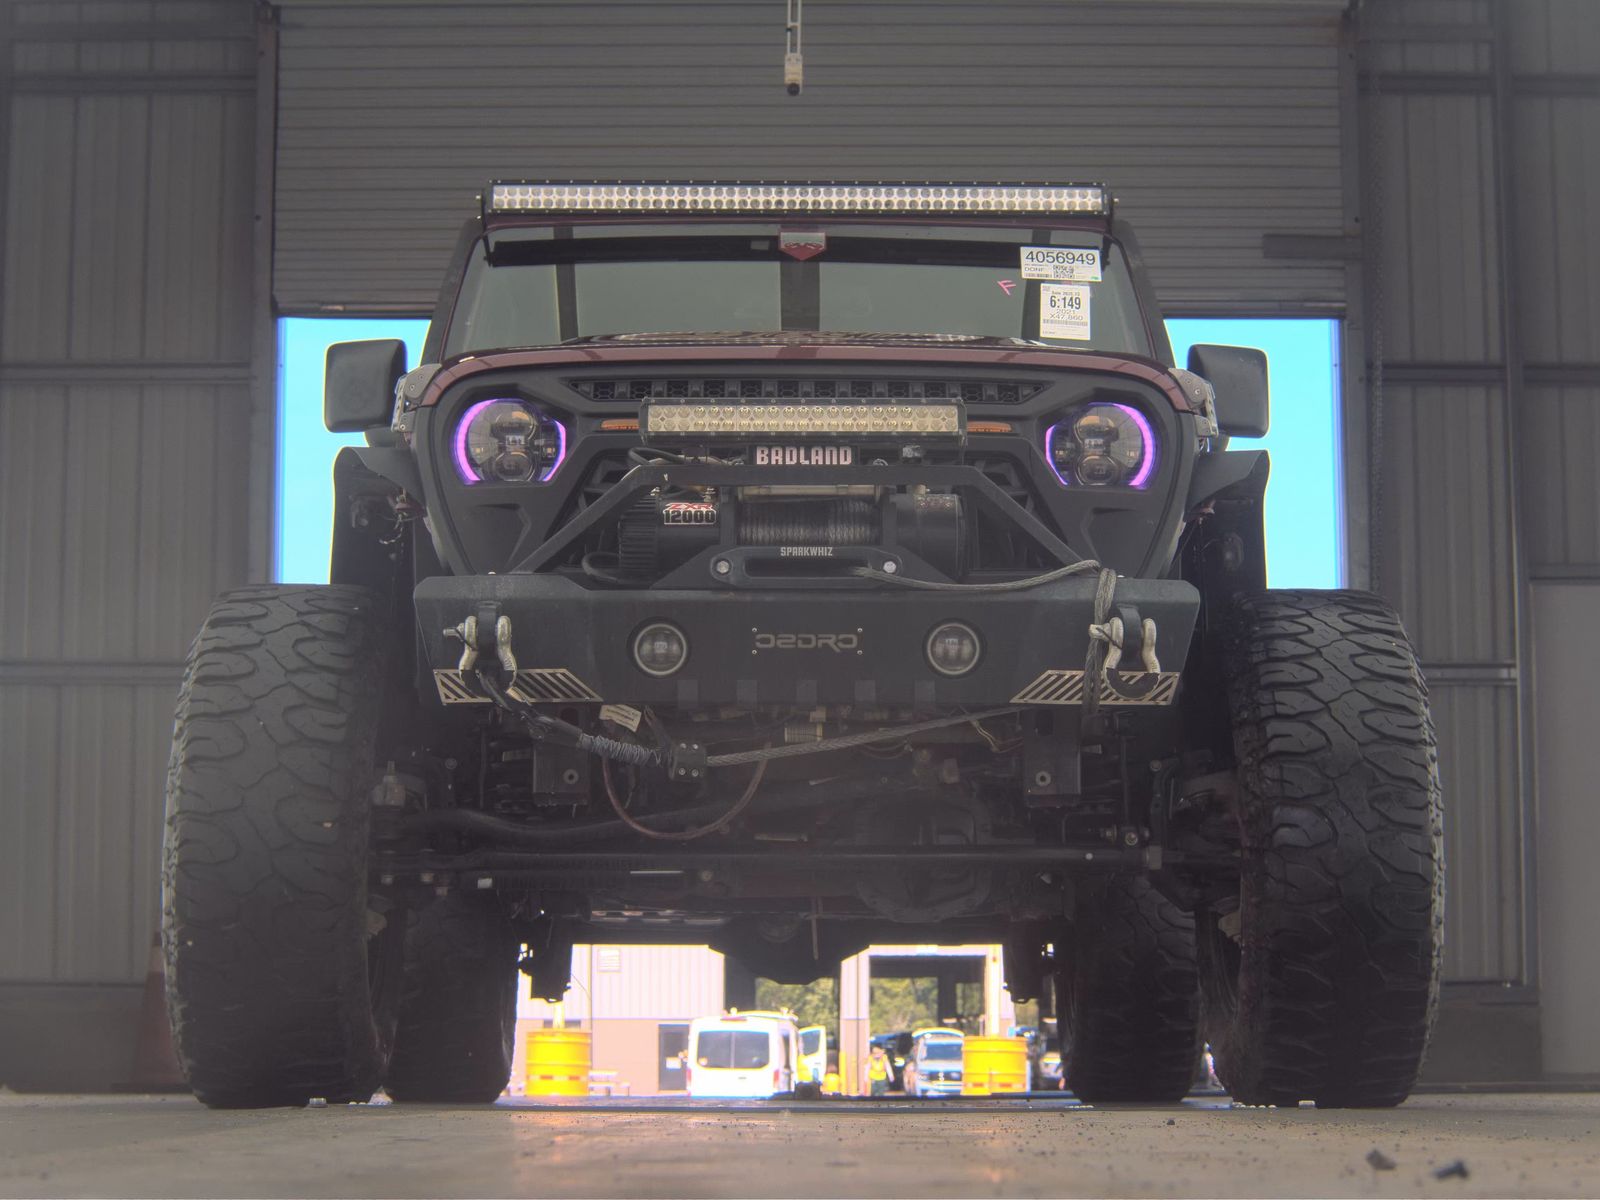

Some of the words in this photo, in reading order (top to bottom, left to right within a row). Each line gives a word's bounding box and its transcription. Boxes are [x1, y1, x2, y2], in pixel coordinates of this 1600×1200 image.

[1025, 251, 1096, 265] 4056949
[1049, 295, 1081, 310] 6:149
[756, 445, 852, 465] BADLAND
[662, 509, 717, 525] 12000
[780, 546, 833, 557] SPARKWHIZ
